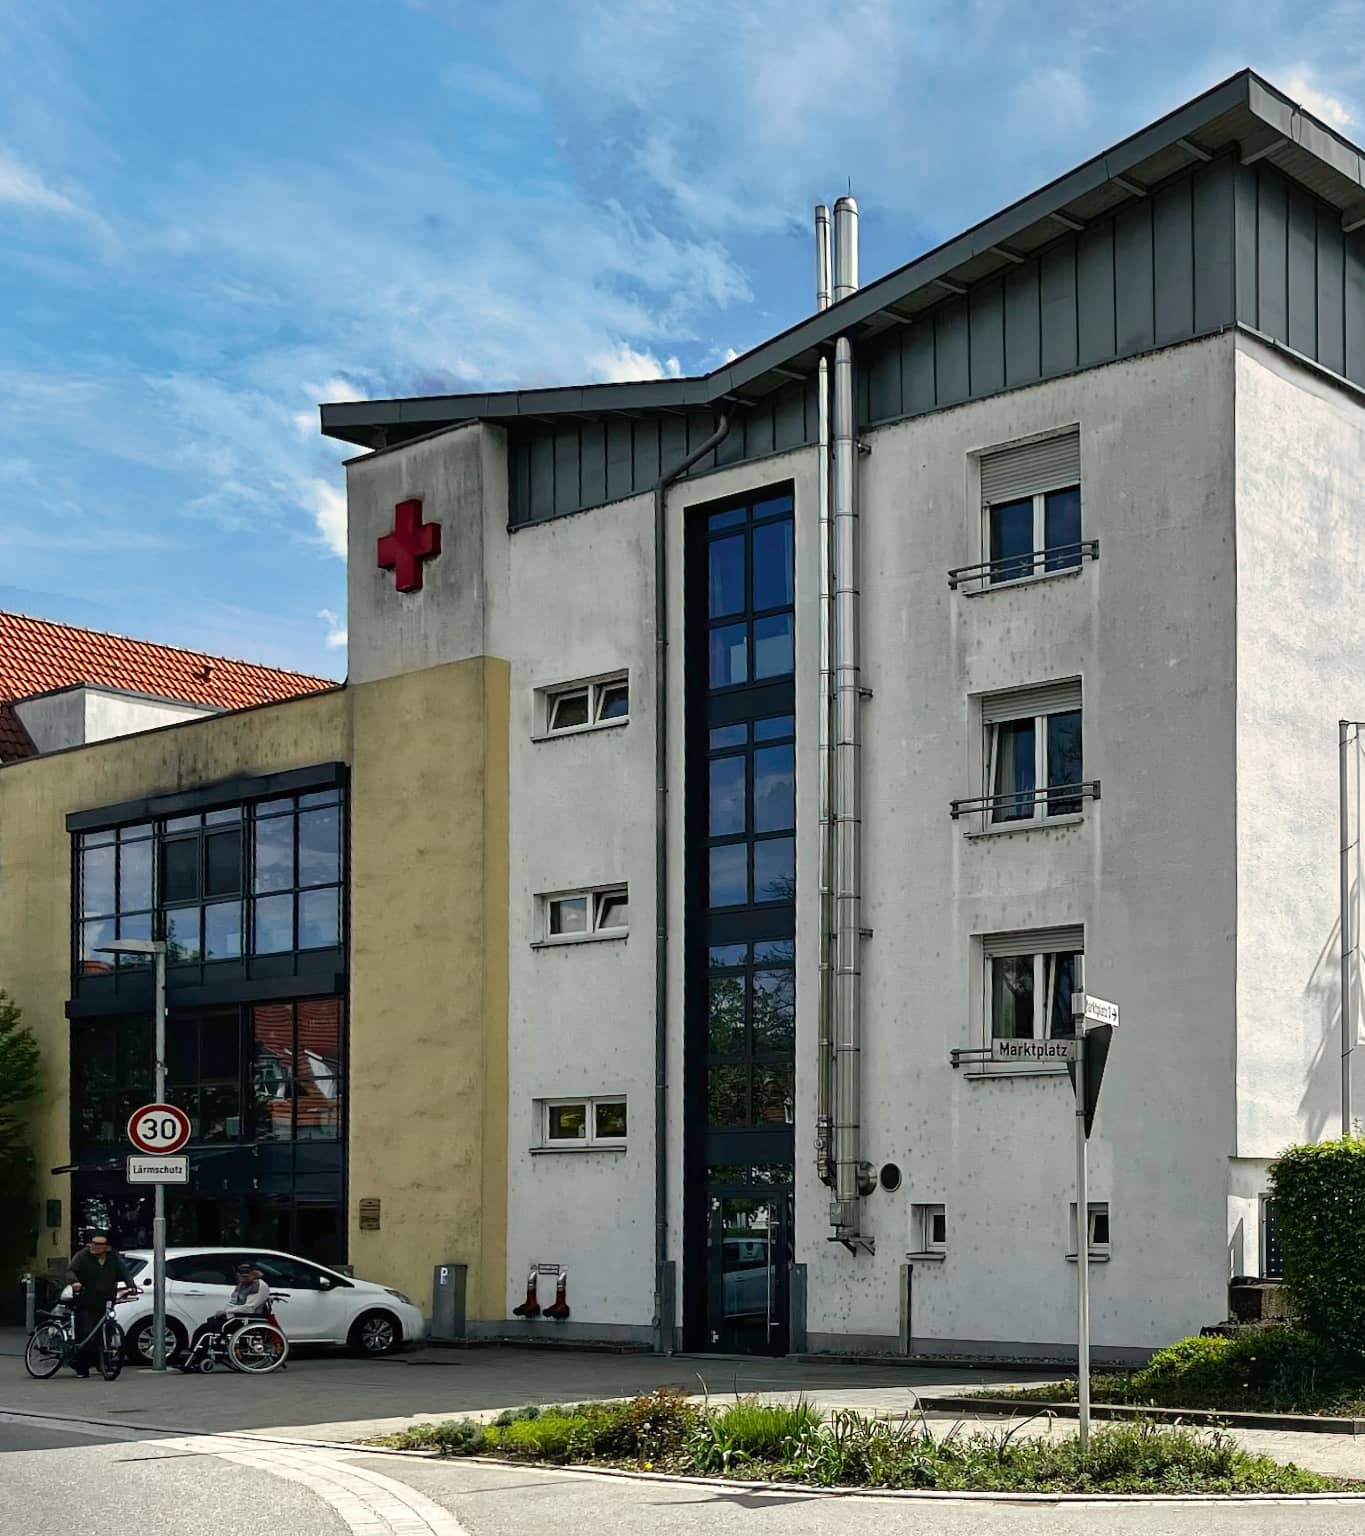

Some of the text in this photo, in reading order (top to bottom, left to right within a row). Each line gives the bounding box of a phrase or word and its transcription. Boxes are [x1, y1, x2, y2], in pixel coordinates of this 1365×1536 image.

[1000, 1042, 1068, 1059] Marktplatz
[142, 1118, 177, 1140] 30
[133, 1165, 183, 1174] Lärmschutz
